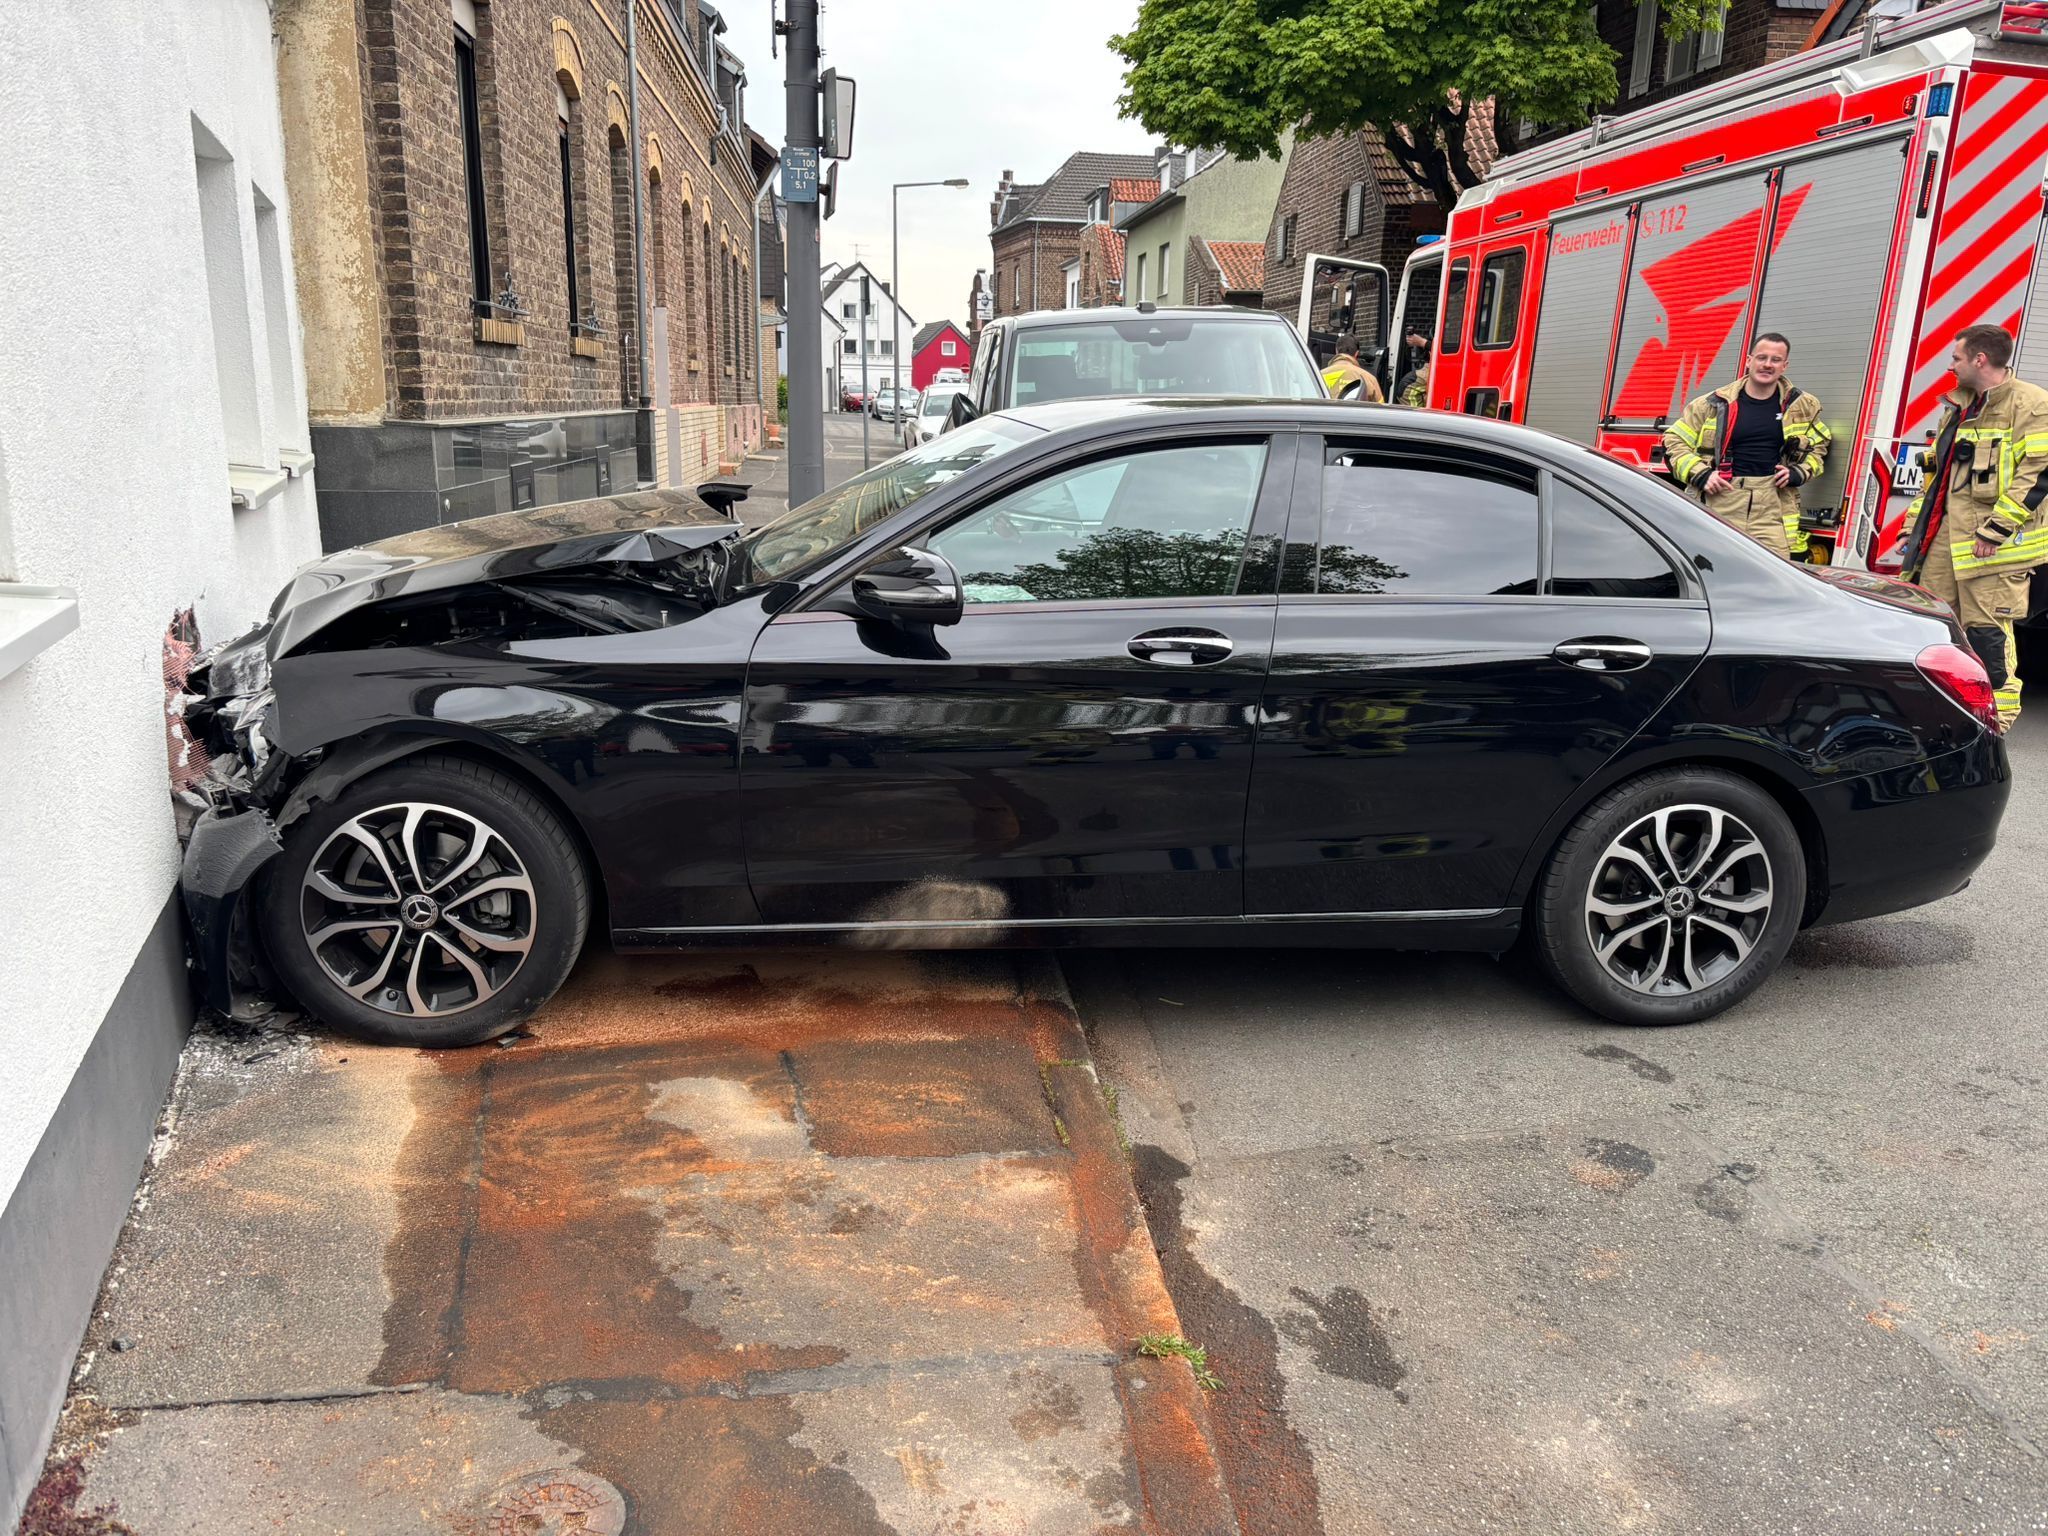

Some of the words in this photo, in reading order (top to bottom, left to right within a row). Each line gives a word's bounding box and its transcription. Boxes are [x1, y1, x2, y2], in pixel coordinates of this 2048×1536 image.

[802, 159, 816, 168] 100
[795, 181, 806, 189] 5.1
[1552, 219, 1624, 256] Feuerwehr
[1659, 204, 1687, 235] 112
[1896, 467, 1918, 486] LN
[1593, 791, 1674, 853] GOODYEAR
[1692, 949, 1773, 1011] GOODYEAR
